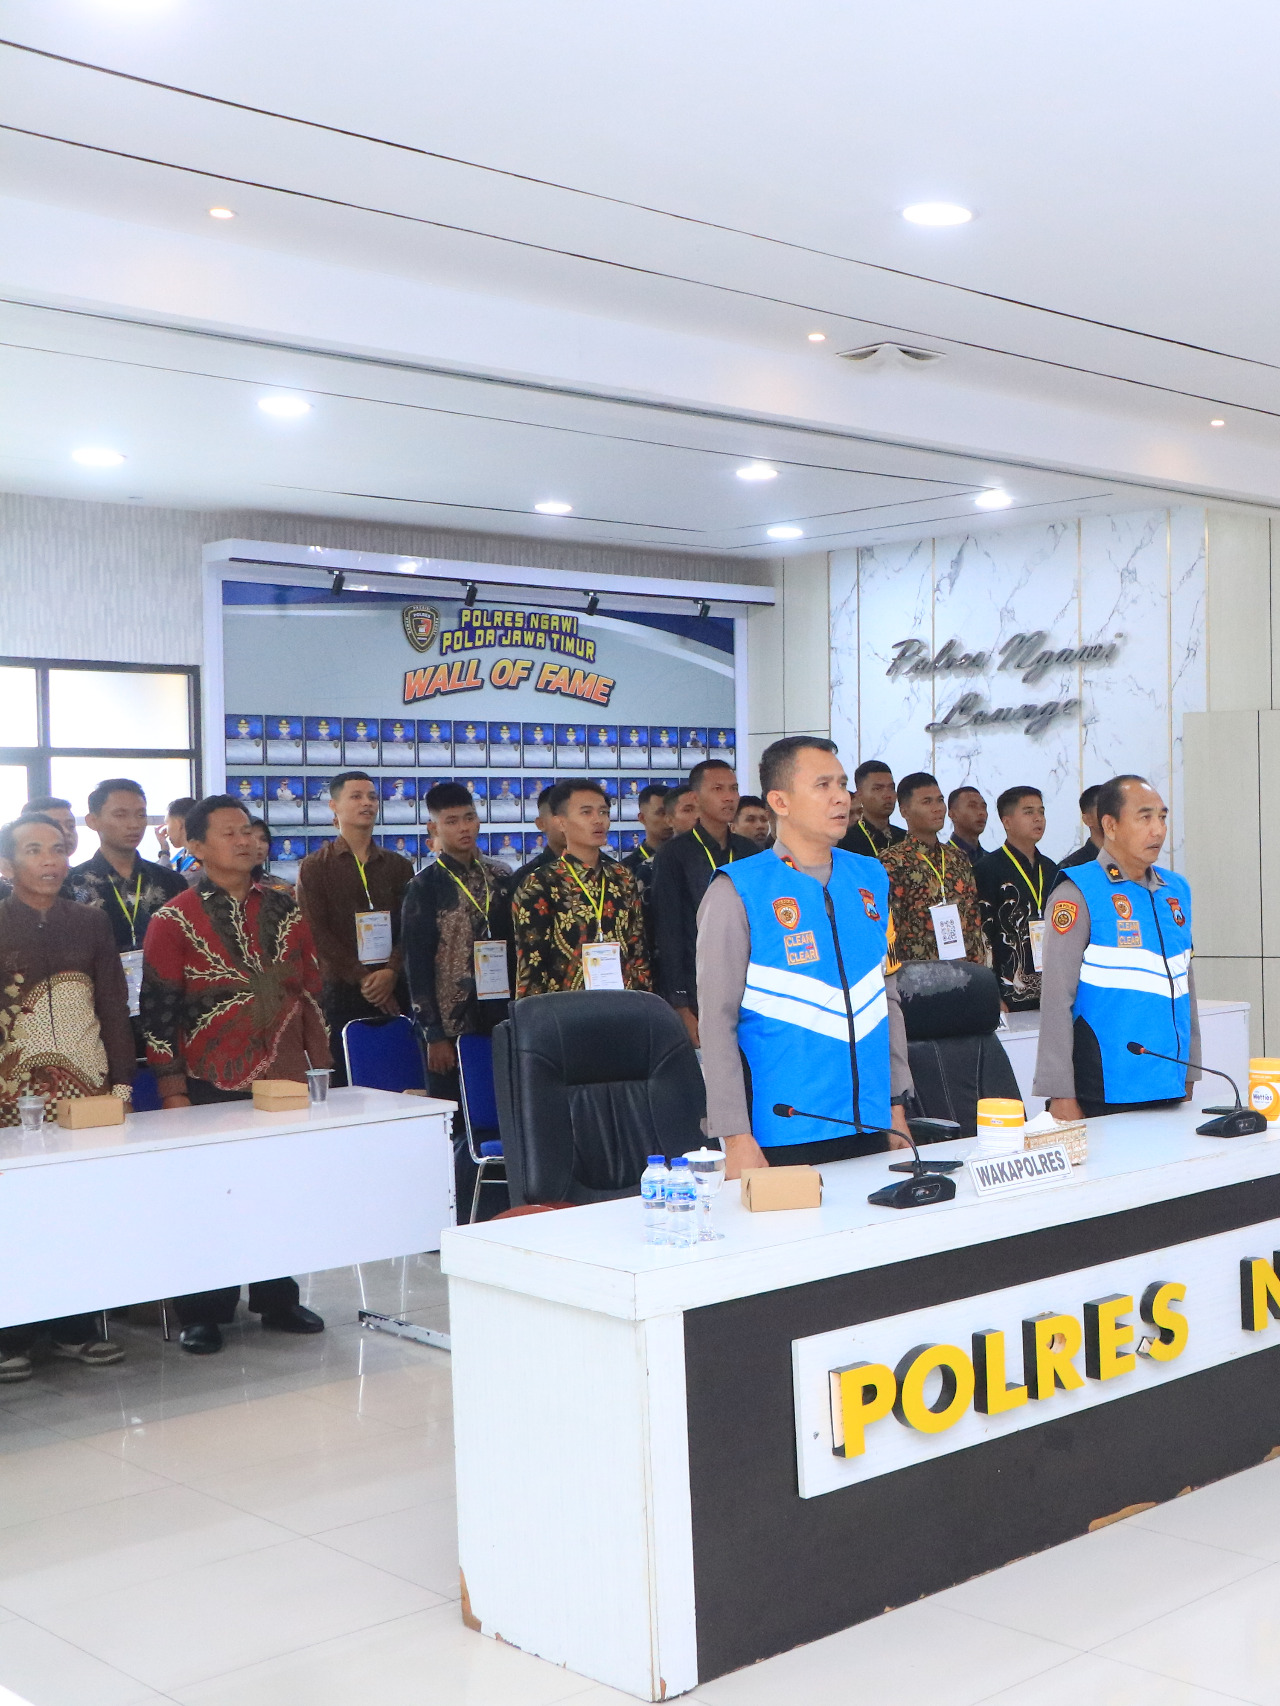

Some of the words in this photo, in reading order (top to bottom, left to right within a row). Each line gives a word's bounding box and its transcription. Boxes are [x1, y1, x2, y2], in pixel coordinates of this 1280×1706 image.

[461, 609, 525, 628] POLRES
[530, 613, 578, 634] NGAWI
[442, 629, 496, 654] POLDA
[501, 630, 546, 648] JAWA
[551, 633, 595, 661] TIMUR
[404, 659, 483, 702] WALL
[491, 658, 533, 688] OF
[536, 662, 615, 704] FAME
[924, 691, 1081, 735] Lounge
[786, 933, 814, 947] CLEAN
[789, 949, 817, 963] CLEAR
[976, 1150, 1066, 1187] WAKAPOLRES
[828, 1280, 1189, 1458] POLRES
